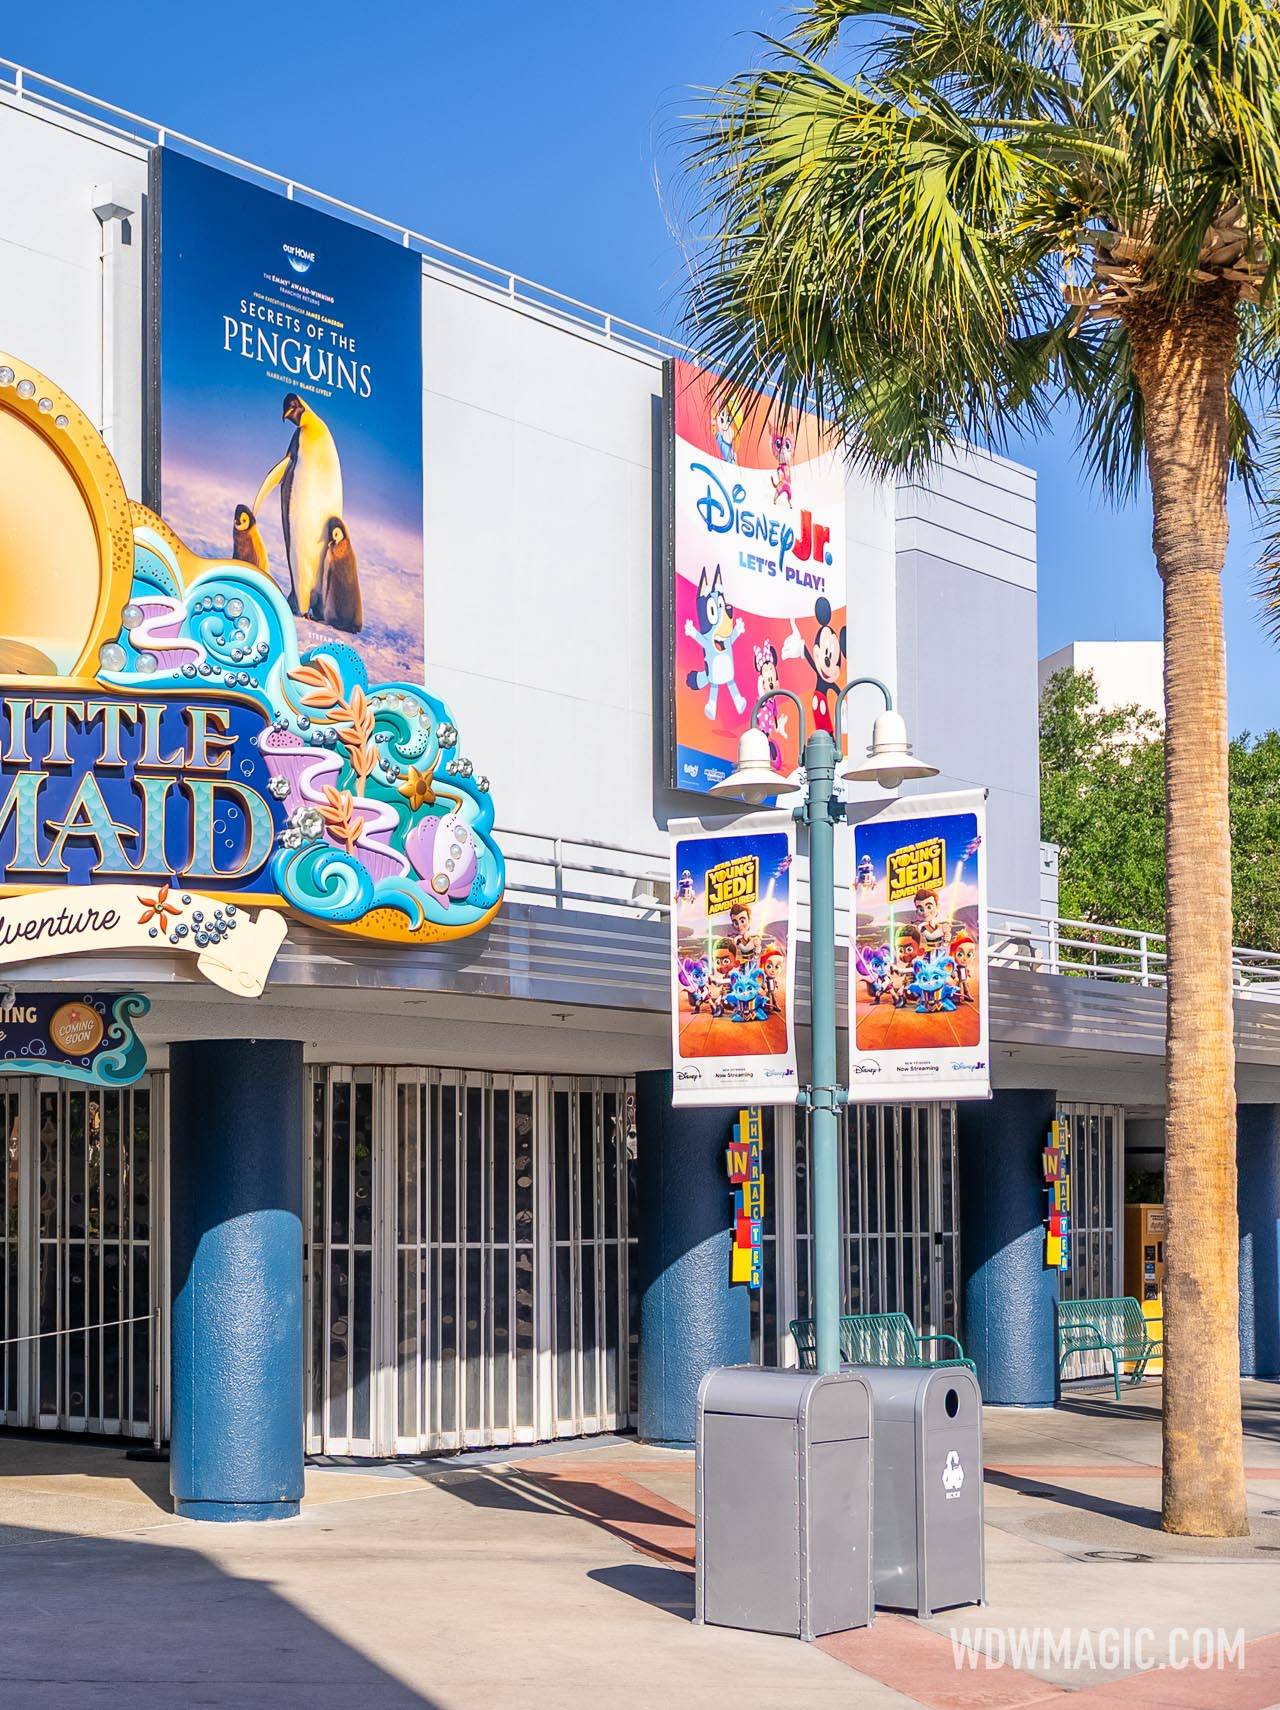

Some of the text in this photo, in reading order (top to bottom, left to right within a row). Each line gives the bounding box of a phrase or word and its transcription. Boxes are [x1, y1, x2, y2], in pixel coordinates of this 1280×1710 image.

[240, 299, 356, 353] SECRETS OF THE
[305, 309, 321, 321] JAMES
[320, 315, 344, 329] CAMERON
[222, 315, 372, 399] PENGUINS
[299, 382, 316, 393] BLAKE
[791, 509, 833, 566] Jr.
[738, 551, 826, 593] LET'S PLAY!
[890, 844, 942, 871] YOUNG
[708, 861, 756, 885] YOUNG
[890, 857, 940, 889] JEDI
[708, 873, 754, 903] JEDI
[59, 1020, 96, 1038] COMING
[65, 1030, 92, 1044] SOON
[726, 1150, 748, 1175] IN
[1042, 1153, 1059, 1176] IN
[1058, 1115, 1068, 1269] CHARACTER
